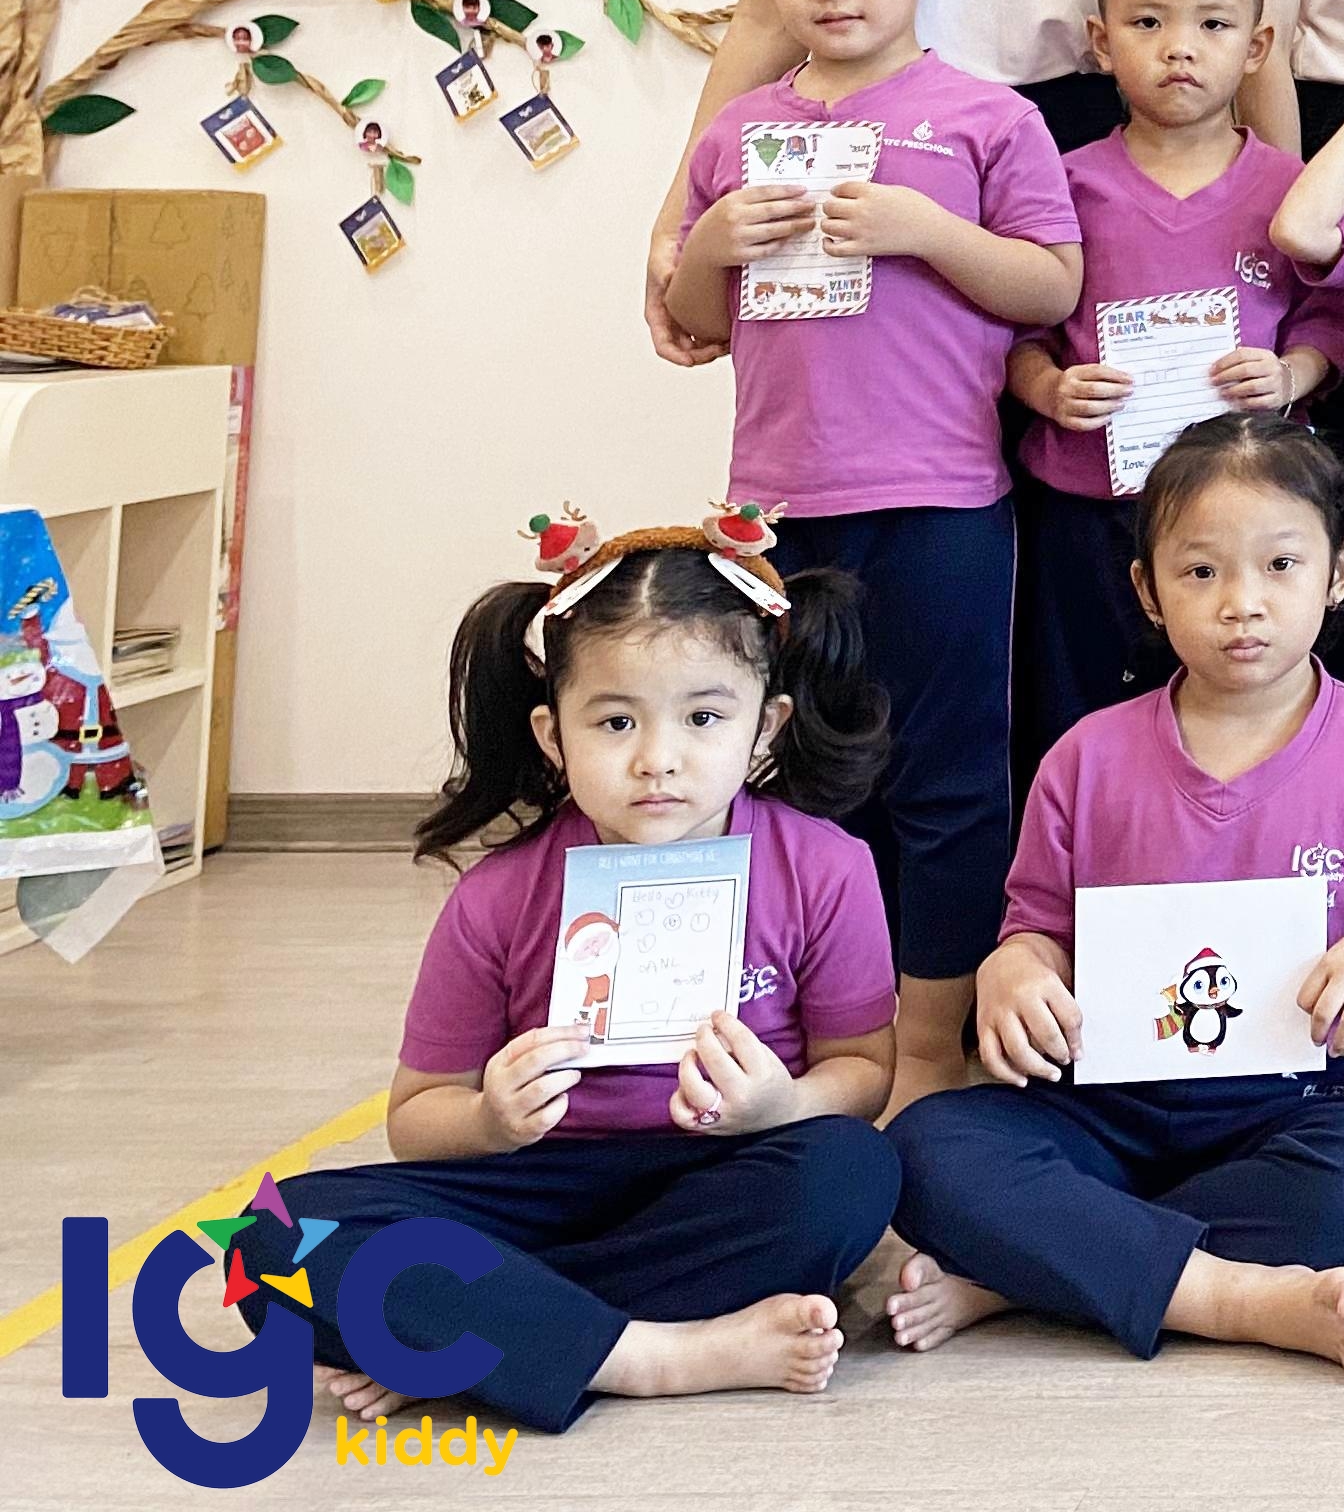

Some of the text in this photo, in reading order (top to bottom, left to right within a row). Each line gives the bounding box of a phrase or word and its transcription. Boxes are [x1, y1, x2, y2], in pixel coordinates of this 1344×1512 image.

[829, 278, 863, 291] SANTA
[1107, 310, 1145, 325] DEAR
[1108, 322, 1147, 337] SANTA
[687, 887, 719, 904] Kitty
